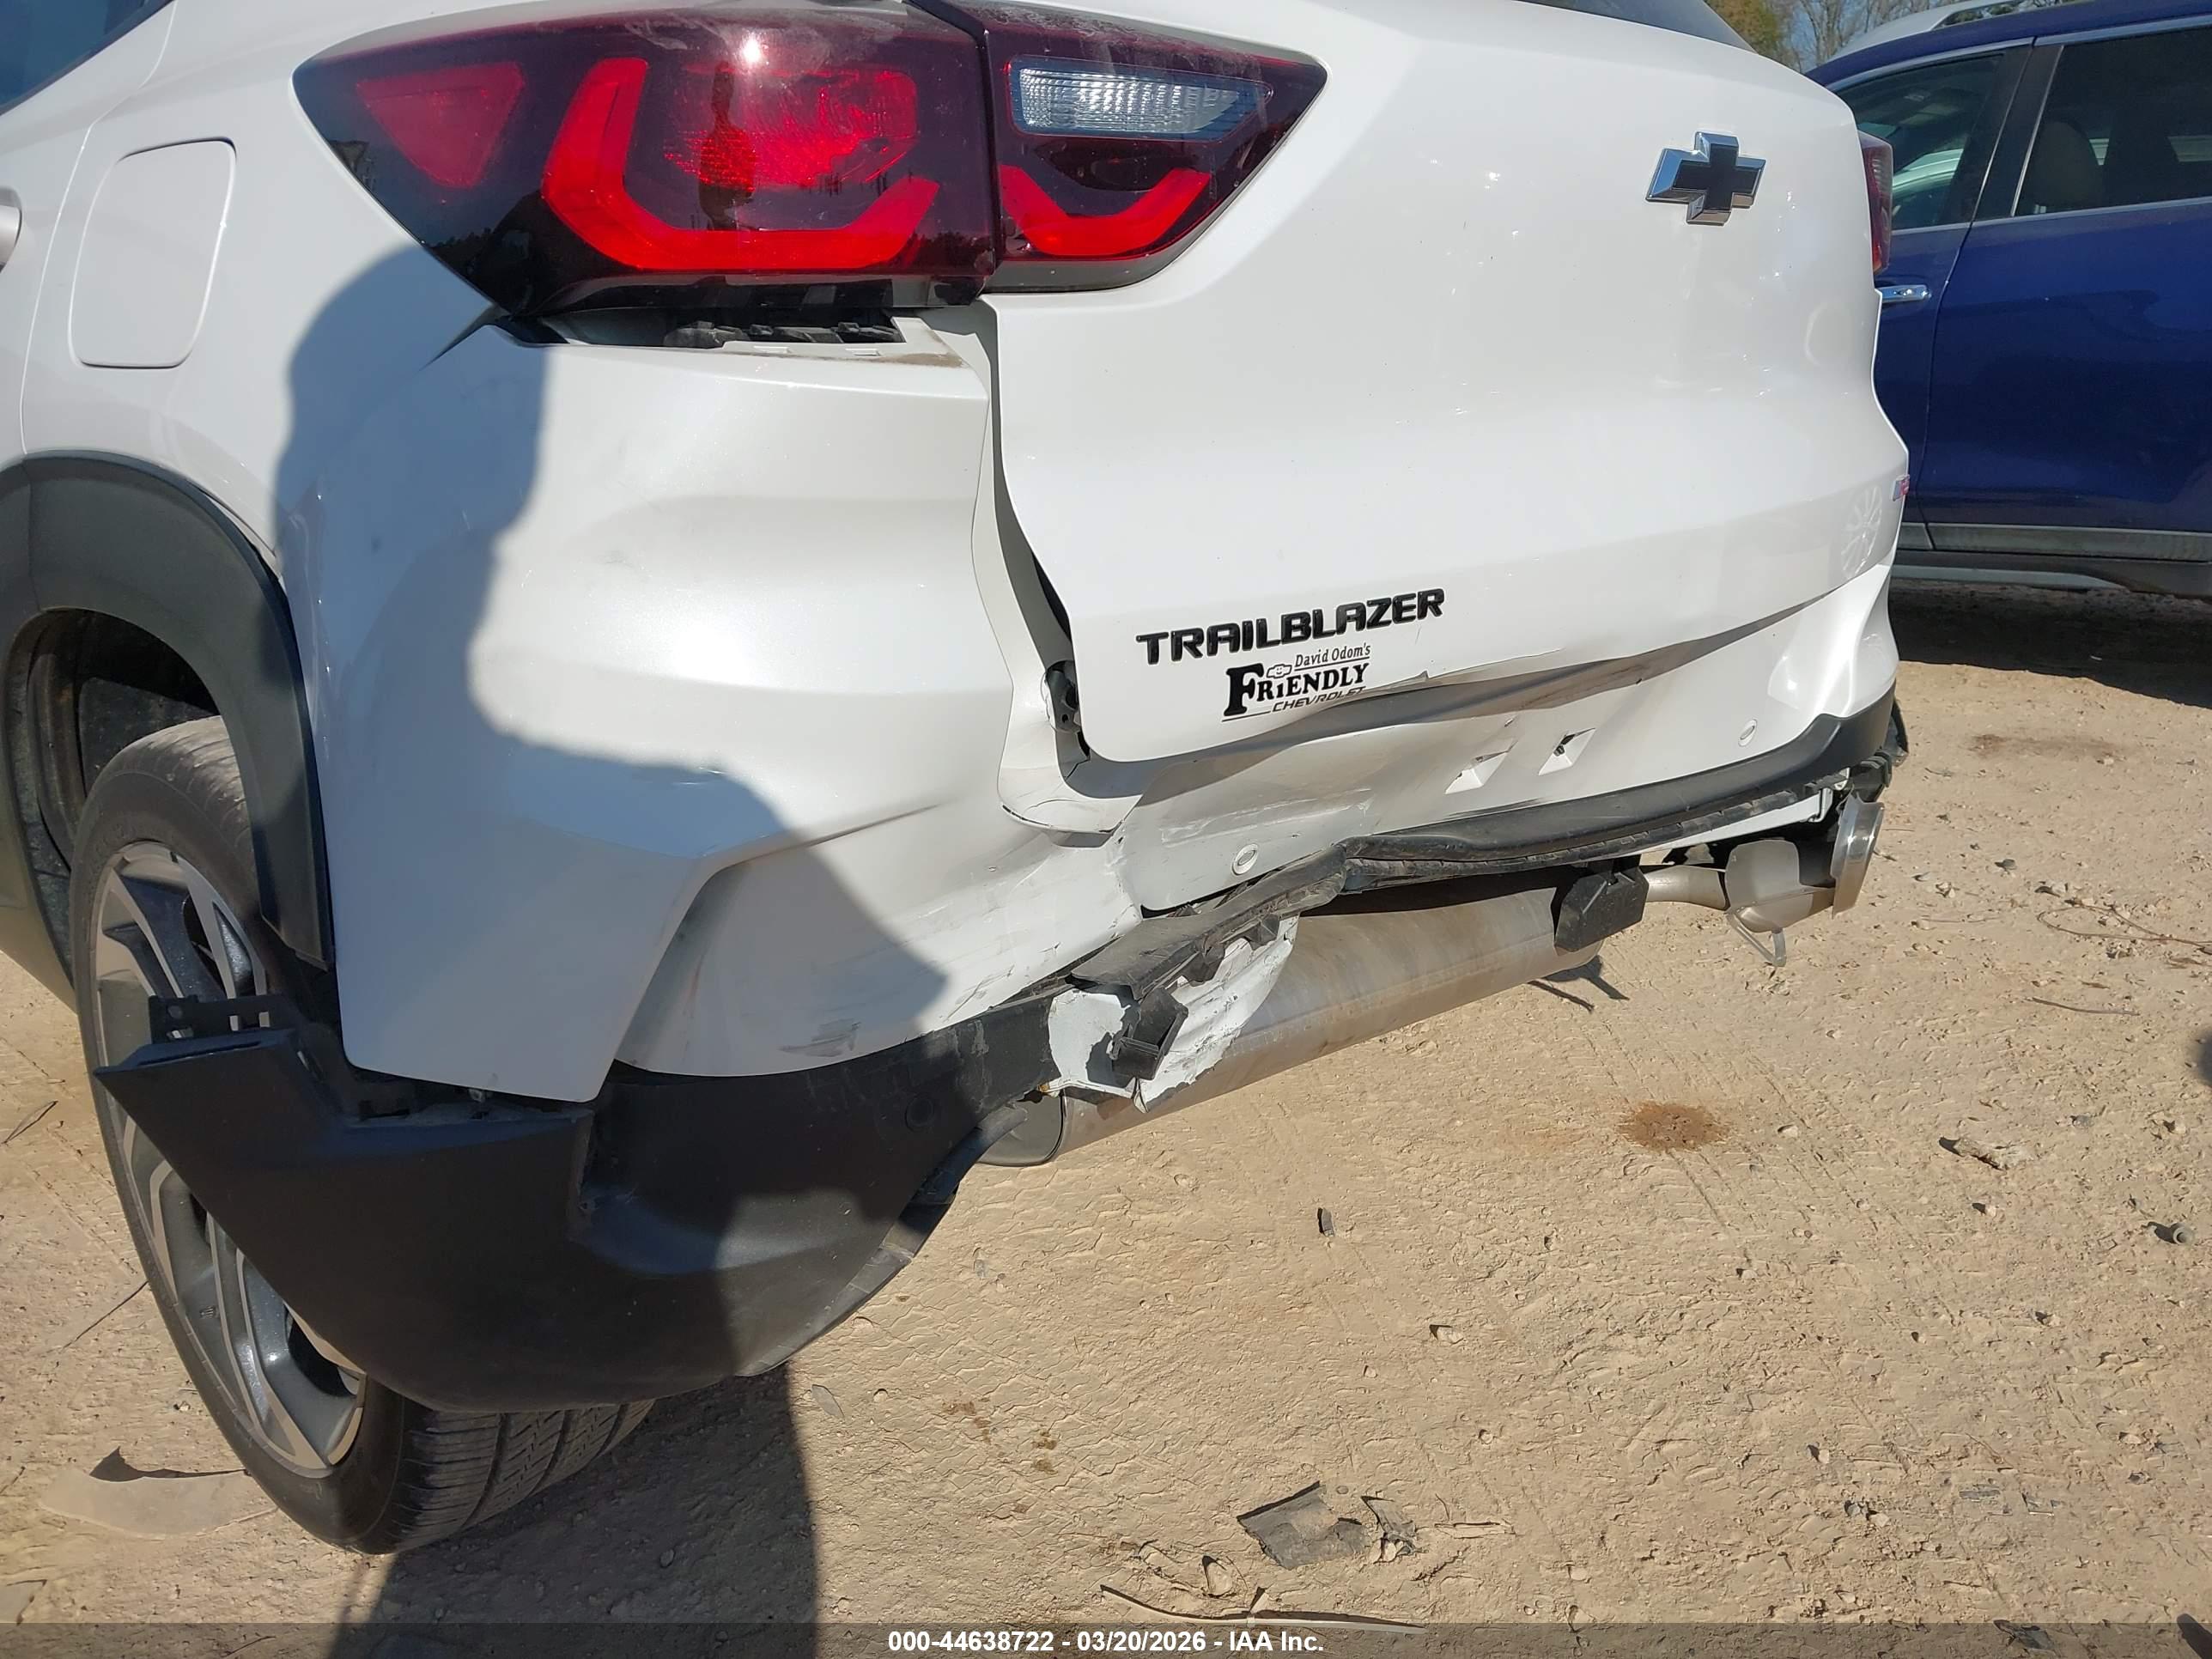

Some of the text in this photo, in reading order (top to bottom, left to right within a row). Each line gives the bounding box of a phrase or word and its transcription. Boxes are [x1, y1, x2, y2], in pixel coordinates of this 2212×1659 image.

[1136, 588, 1444, 665] TRAILBLAZER
[1295, 643, 1370, 667] David Odom's
[1273, 686, 1366, 712] CHEVROLET
